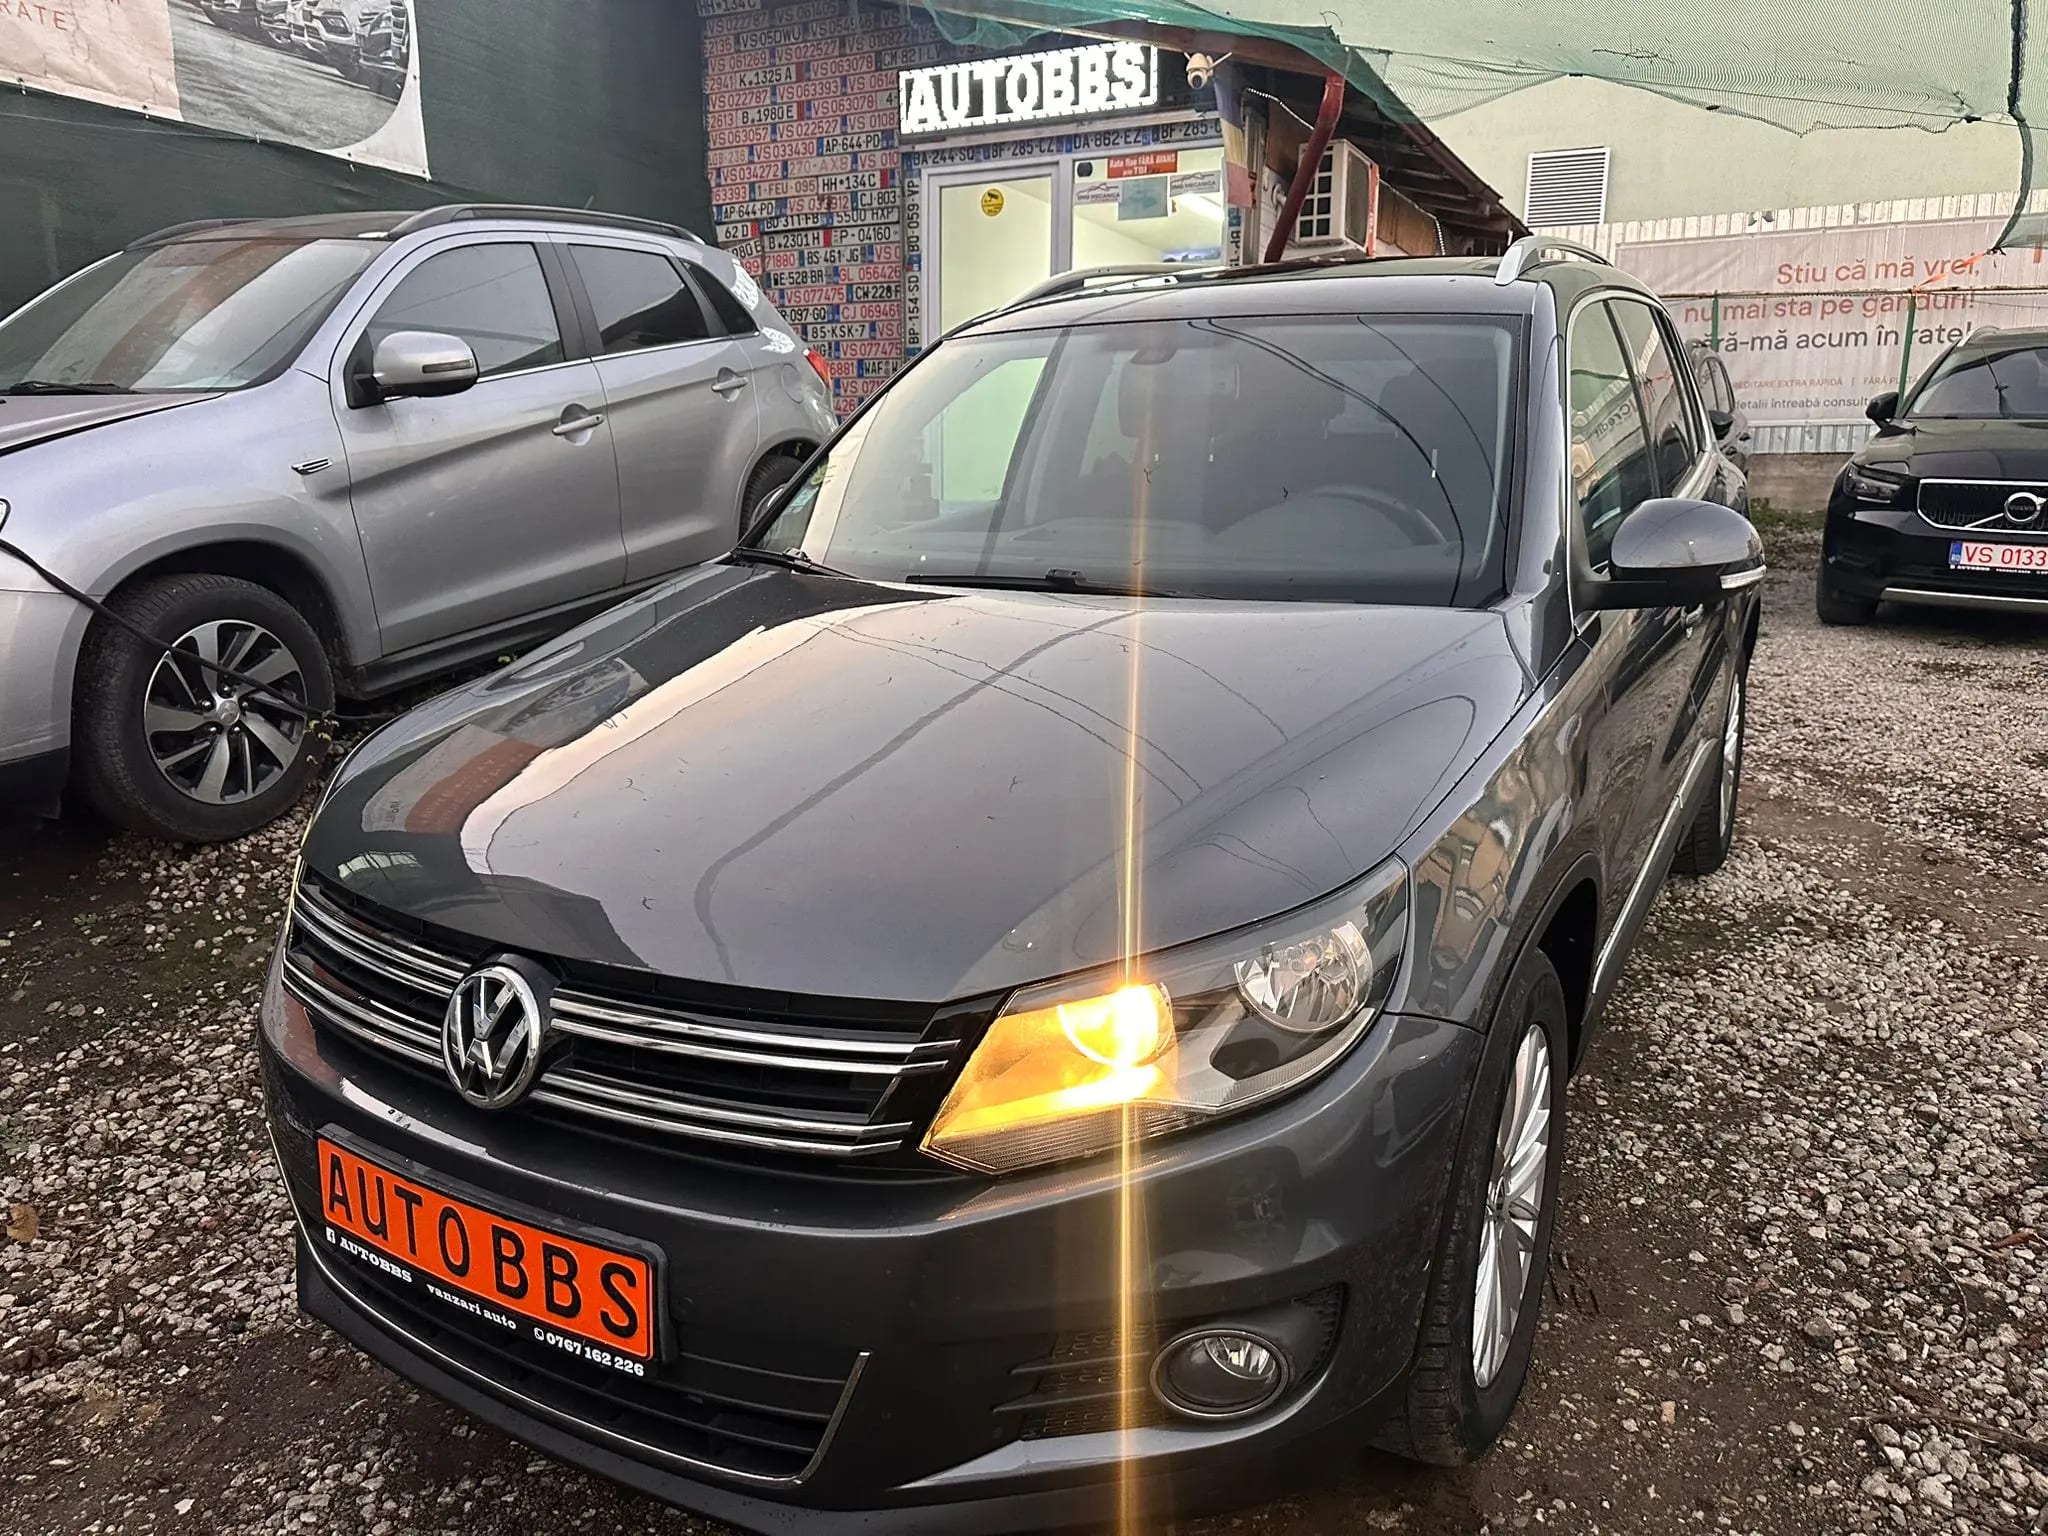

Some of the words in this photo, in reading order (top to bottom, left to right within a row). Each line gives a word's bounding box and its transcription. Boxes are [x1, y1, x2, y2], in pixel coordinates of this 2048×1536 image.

[903, 43, 1150, 127] AUTOBBS
[1835, 258, 1866, 281] că
[1875, 255, 1914, 279] mă
[1684, 306, 1713, 323] nu
[1723, 298, 1767, 320] mai
[1774, 297, 1812, 318] sta
[1820, 296, 1854, 320] pe
[1796, 330, 1868, 349] acum
[1876, 324, 1899, 346] în
[2001, 547, 2048, 567] 0133
[340, 1236, 413, 1283] AUTOBBS
[426, 1283, 481, 1316] vanzari
[483, 1309, 517, 1330] auto
[546, 1331, 582, 1355] 0767
[584, 1346, 612, 1366] 162
[614, 1356, 645, 1377] 226
